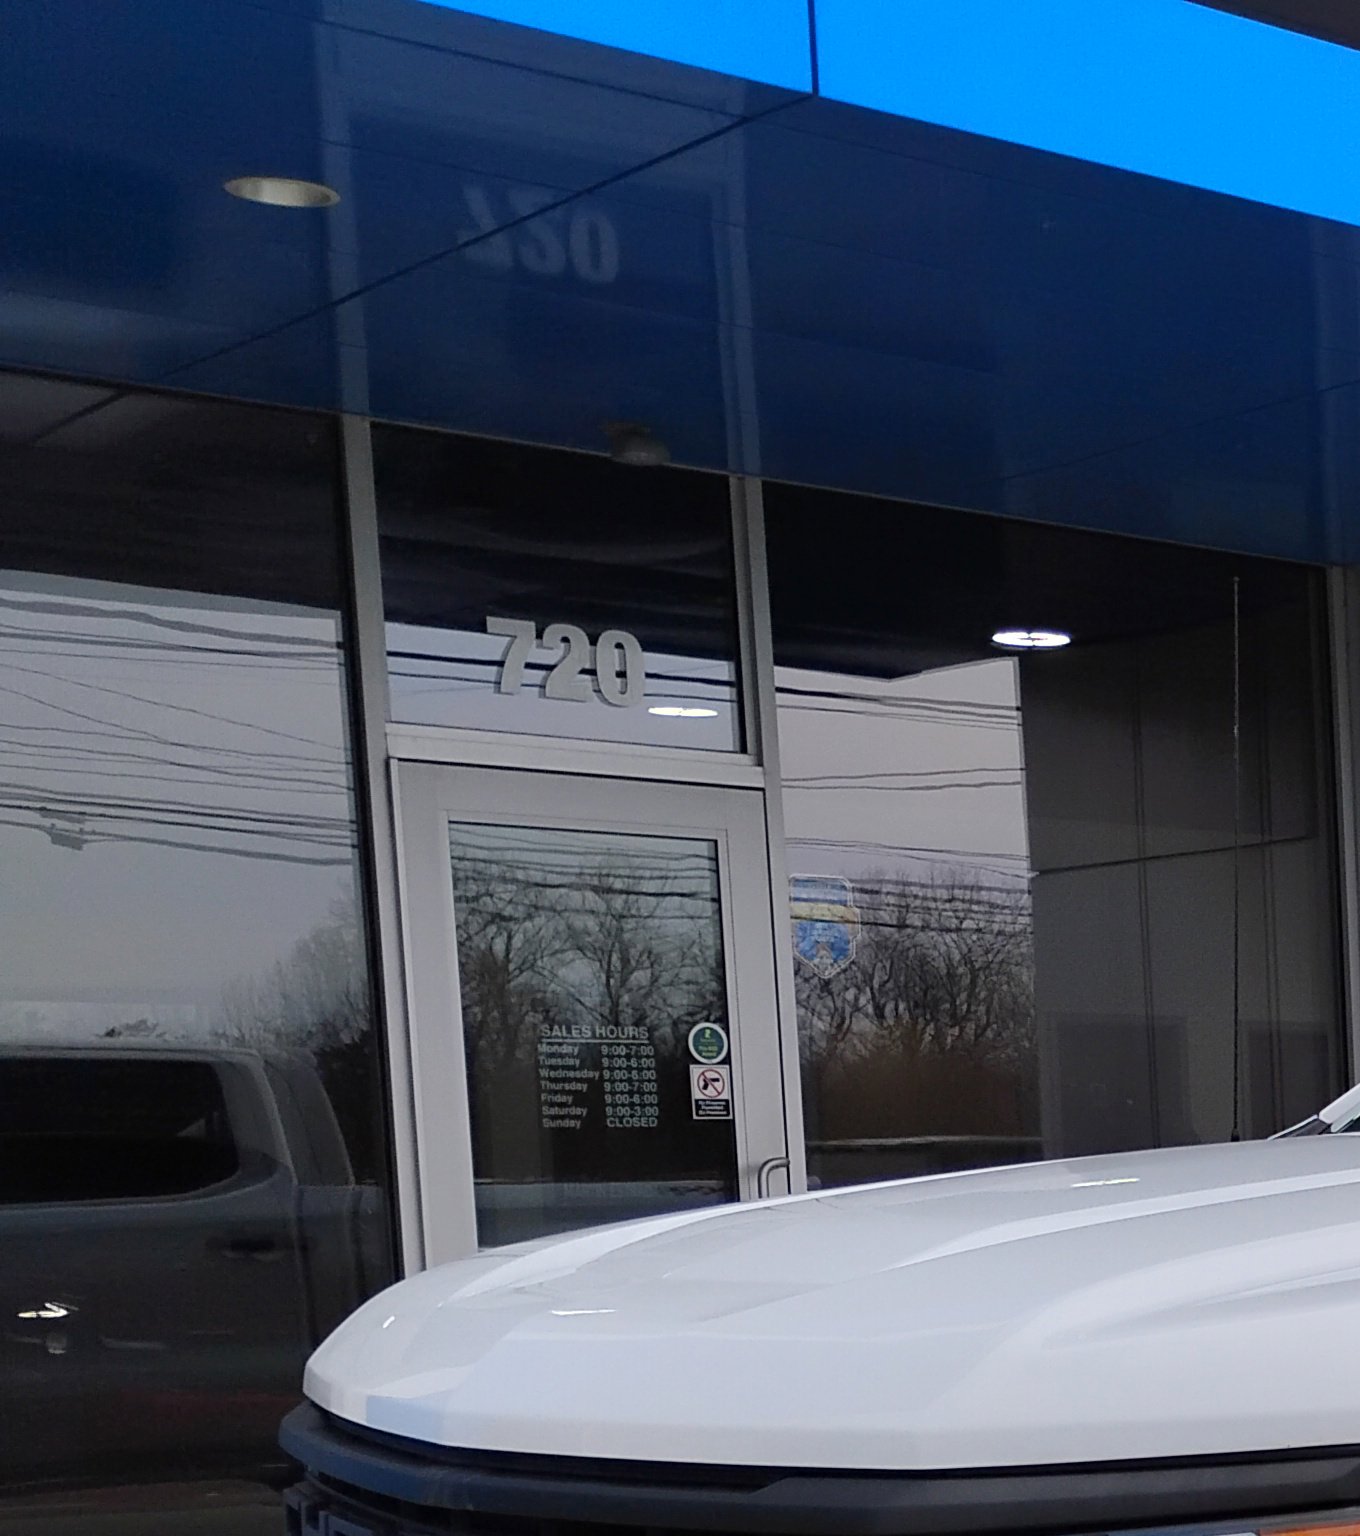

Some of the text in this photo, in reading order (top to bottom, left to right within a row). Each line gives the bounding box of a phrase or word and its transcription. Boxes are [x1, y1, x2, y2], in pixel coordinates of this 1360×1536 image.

[485, 615, 645, 707] 720
[541, 1024, 650, 1039] SALES HOURS
[537, 1043, 655, 1056] Monday 9:00-7:00
[538, 1056, 656, 1068] Tuesday 9:00-6:00
[539, 1068, 599, 1080] Wednesday
[540, 1081, 657, 1093] Thursday 9:00-7:00
[541, 1093, 658, 1105] Friday 9:00-6:00
[542, 1105, 659, 1117] Saturday 9:00-3:00
[543, 1117, 658, 1129] Sunday CLOSED
